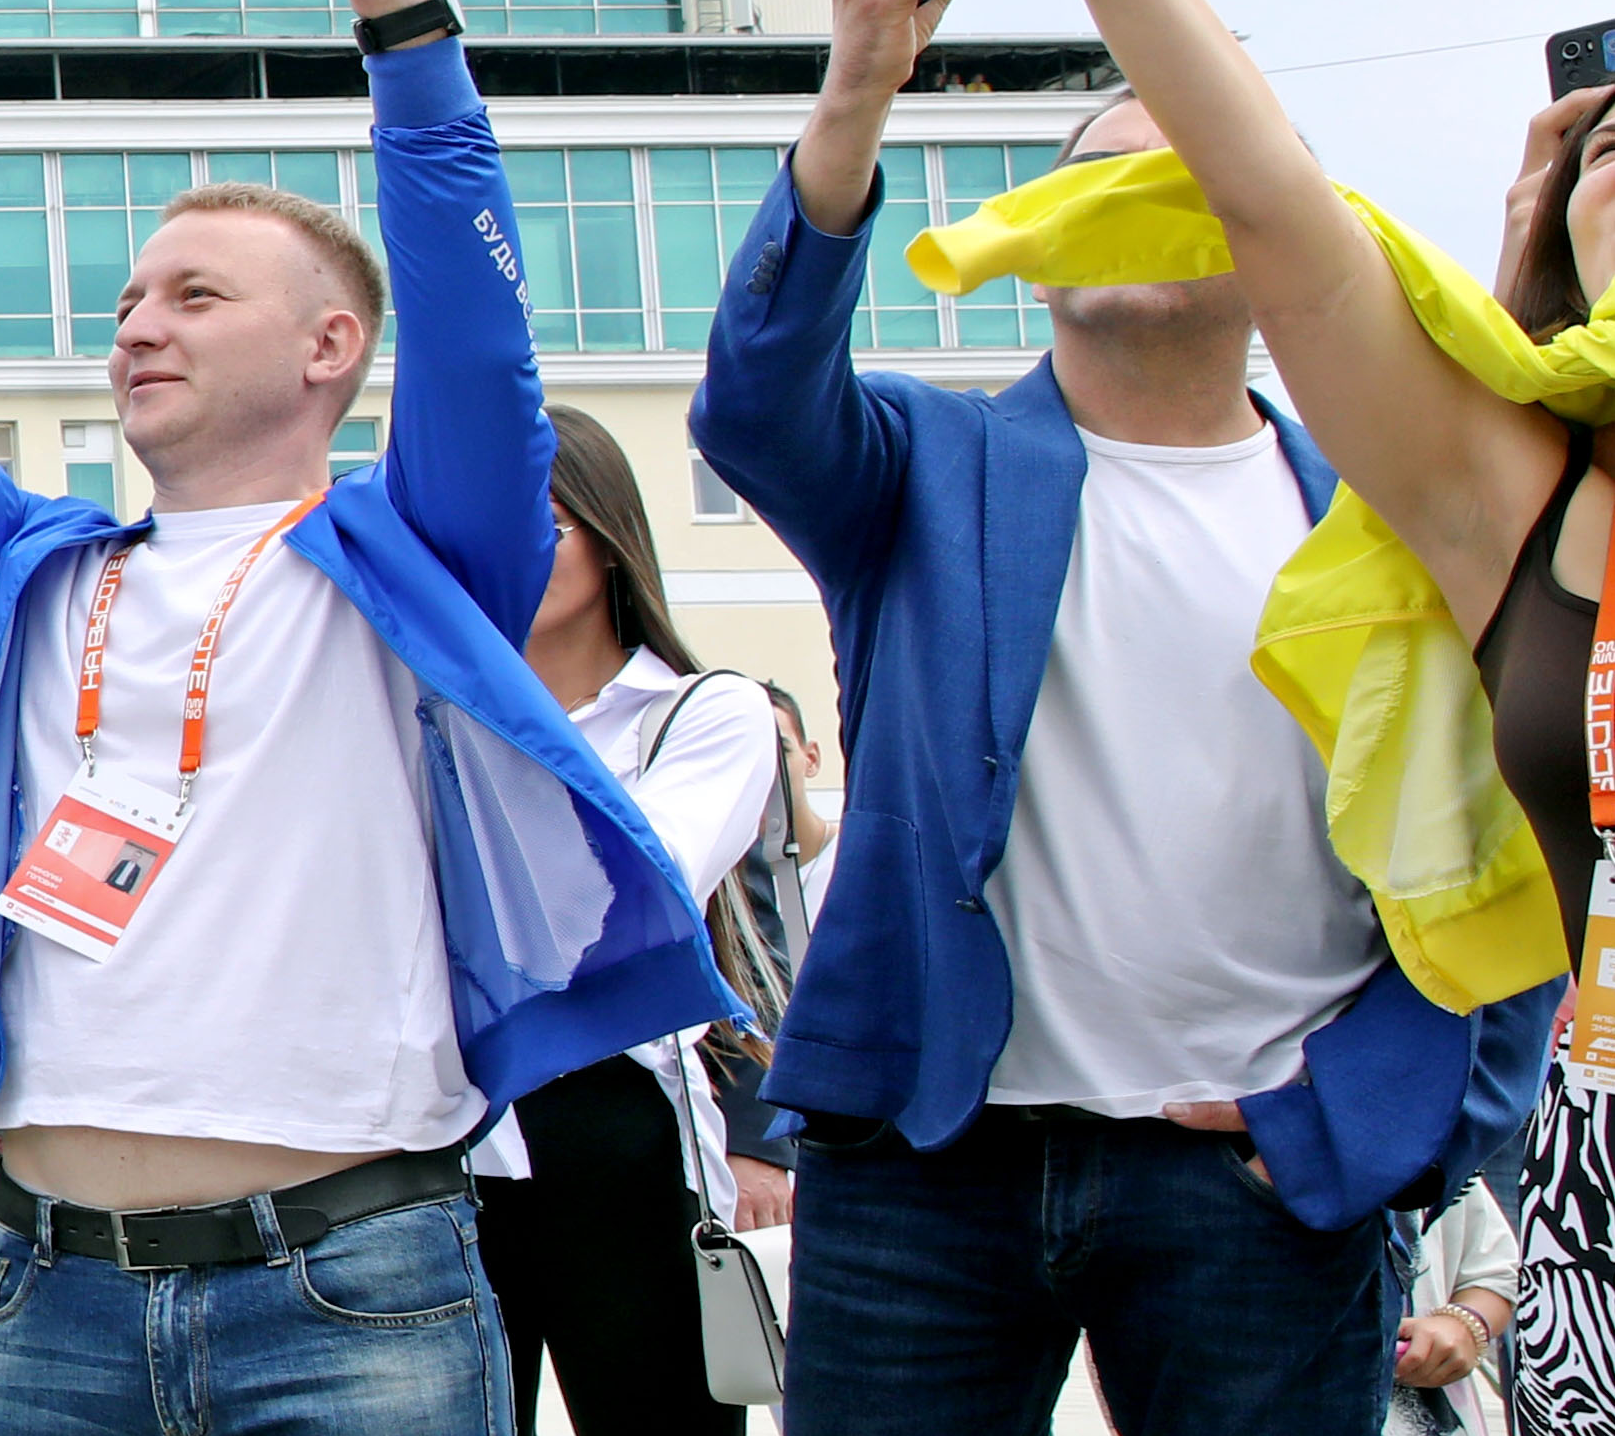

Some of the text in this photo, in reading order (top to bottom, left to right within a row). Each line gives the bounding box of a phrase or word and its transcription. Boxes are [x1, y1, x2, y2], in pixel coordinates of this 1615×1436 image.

[472, 208, 518, 282] БУДЬ
[82, 556, 124, 690] НА ВЫСОТЕ
[189, 553, 259, 691] НА ВЫСОТЕ
